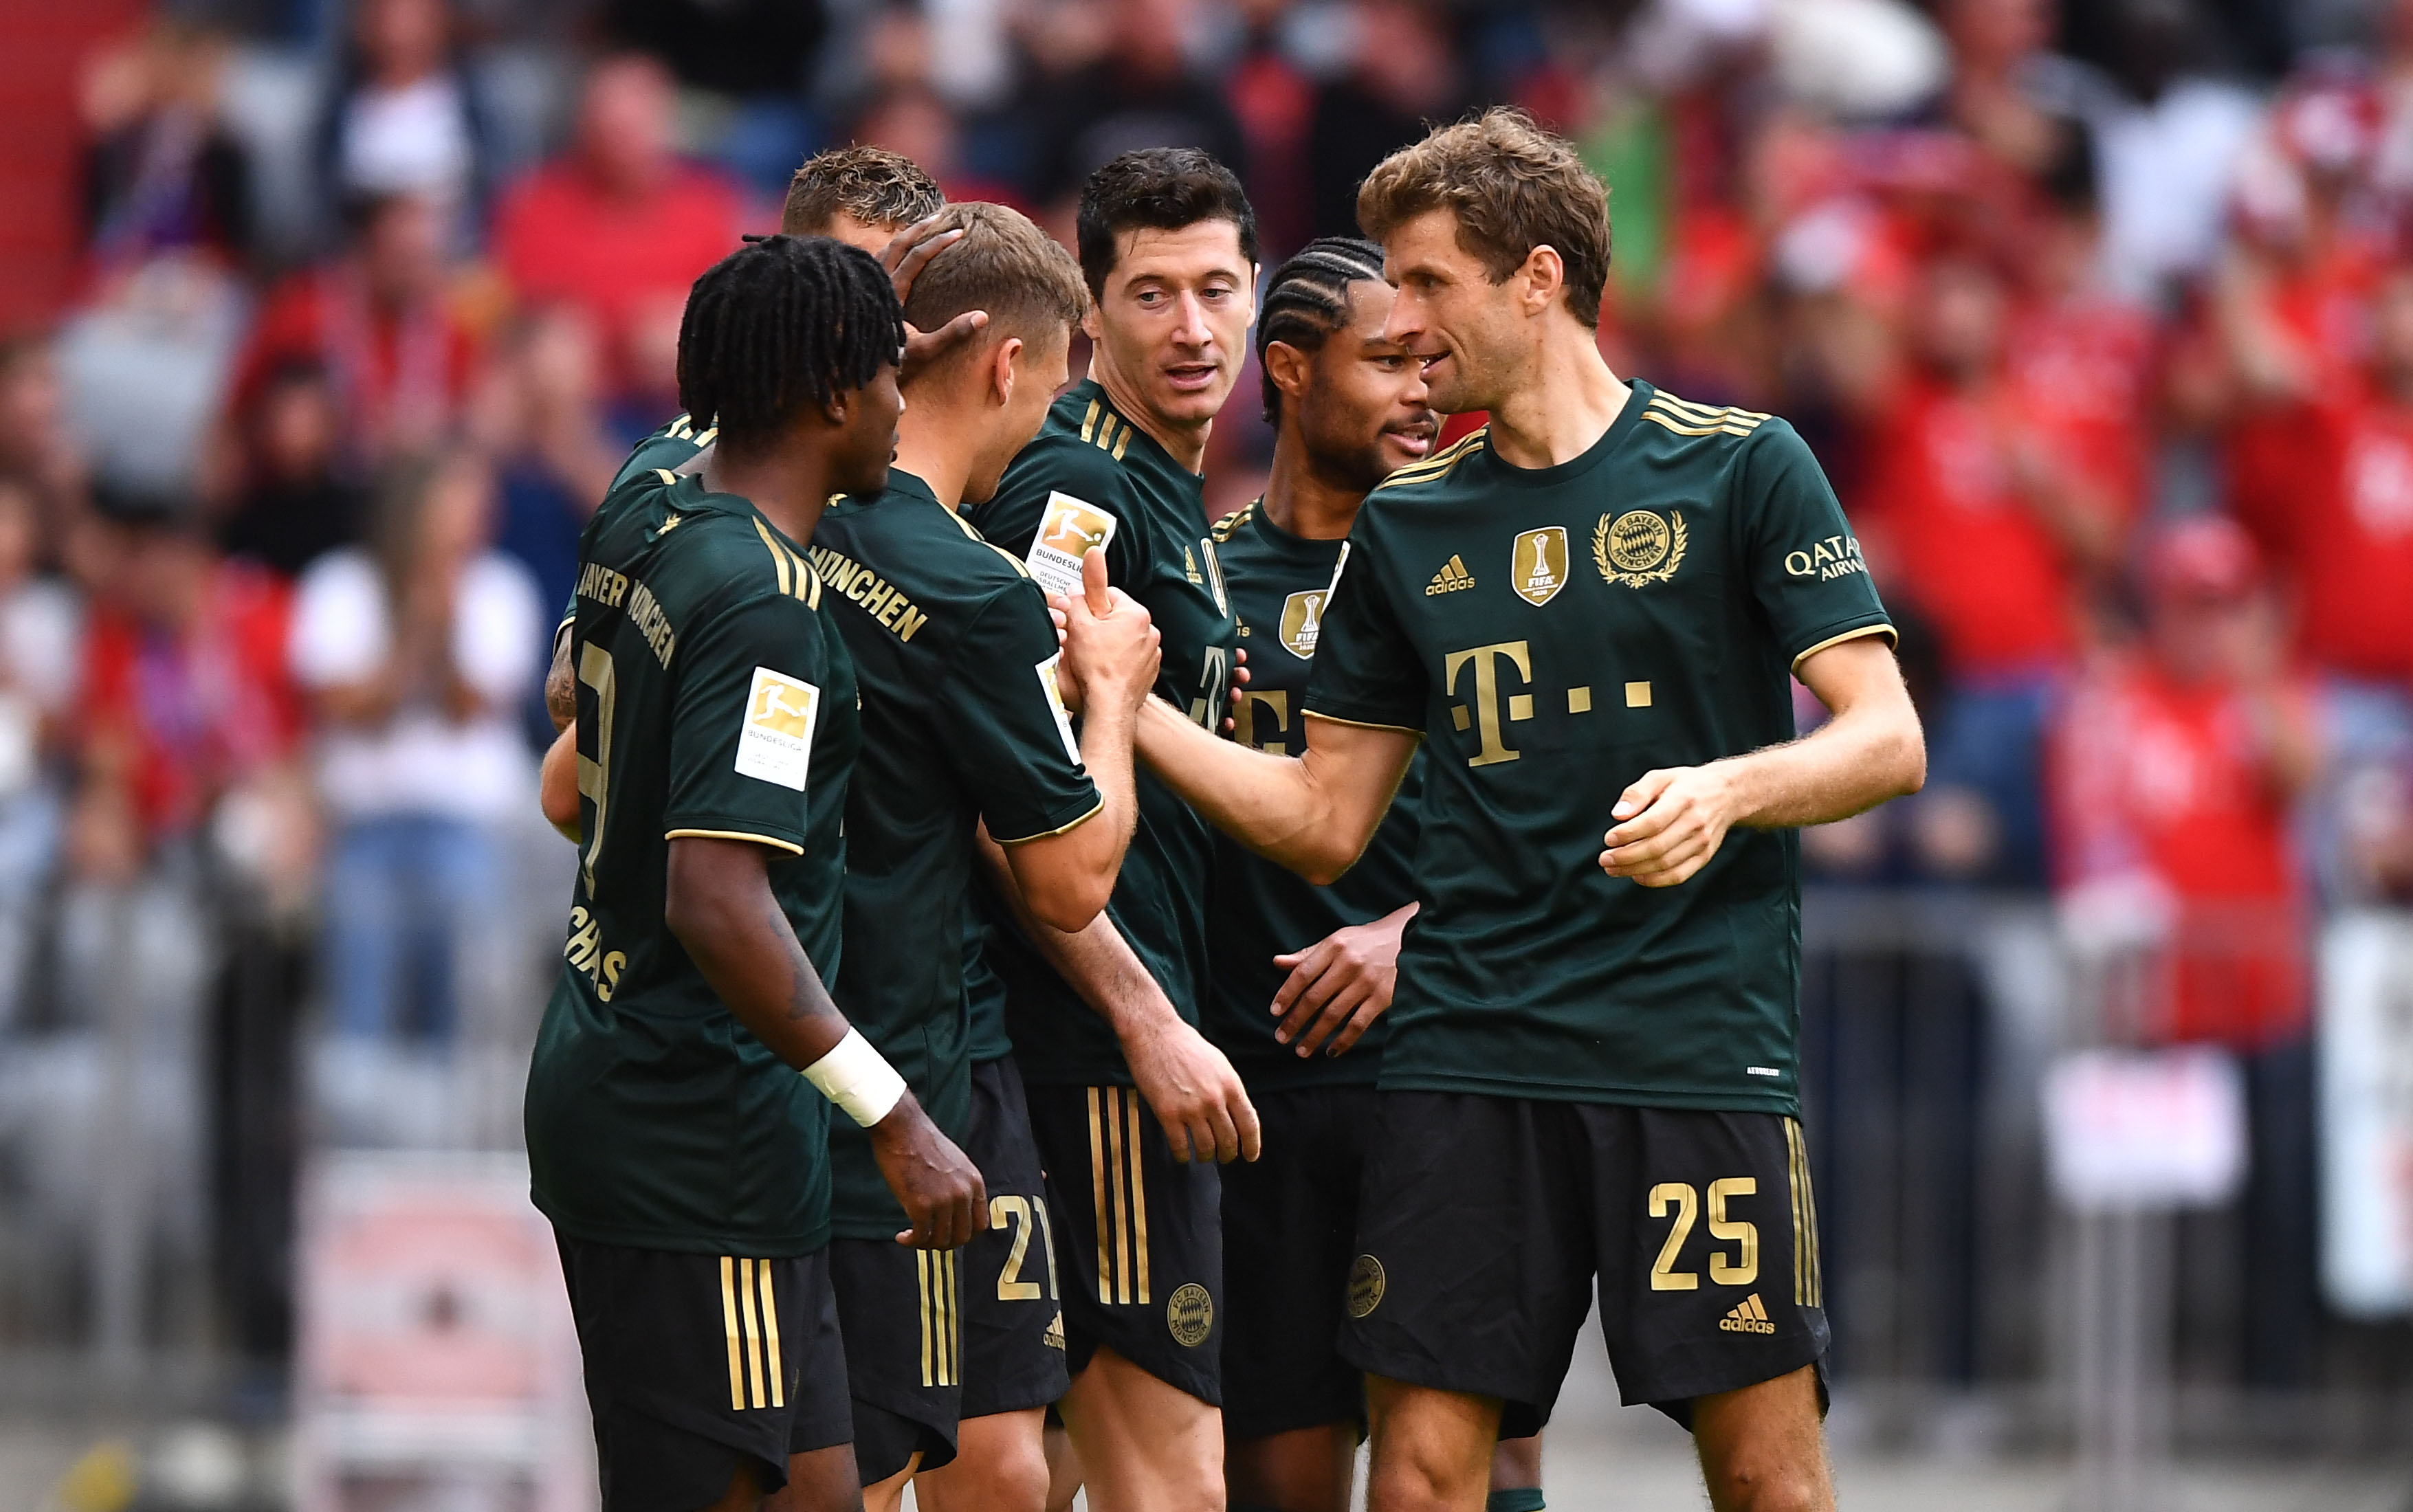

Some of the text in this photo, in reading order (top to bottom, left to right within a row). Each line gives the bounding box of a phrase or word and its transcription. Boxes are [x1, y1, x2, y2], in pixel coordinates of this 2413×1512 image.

[1614, 515, 1664, 537] FC BAYERN
[1036, 548, 1083, 574] BUNDESLI
[1821, 558, 1867, 582] AIRW
[577, 562, 628, 608] AYER
[1425, 577, 1475, 596] adidas
[1528, 576, 1553, 588] FIFA
[1649, 1177, 1759, 1291] 25
[989, 1194, 1059, 1300] 21
[1719, 1316, 1775, 1335] adidas
